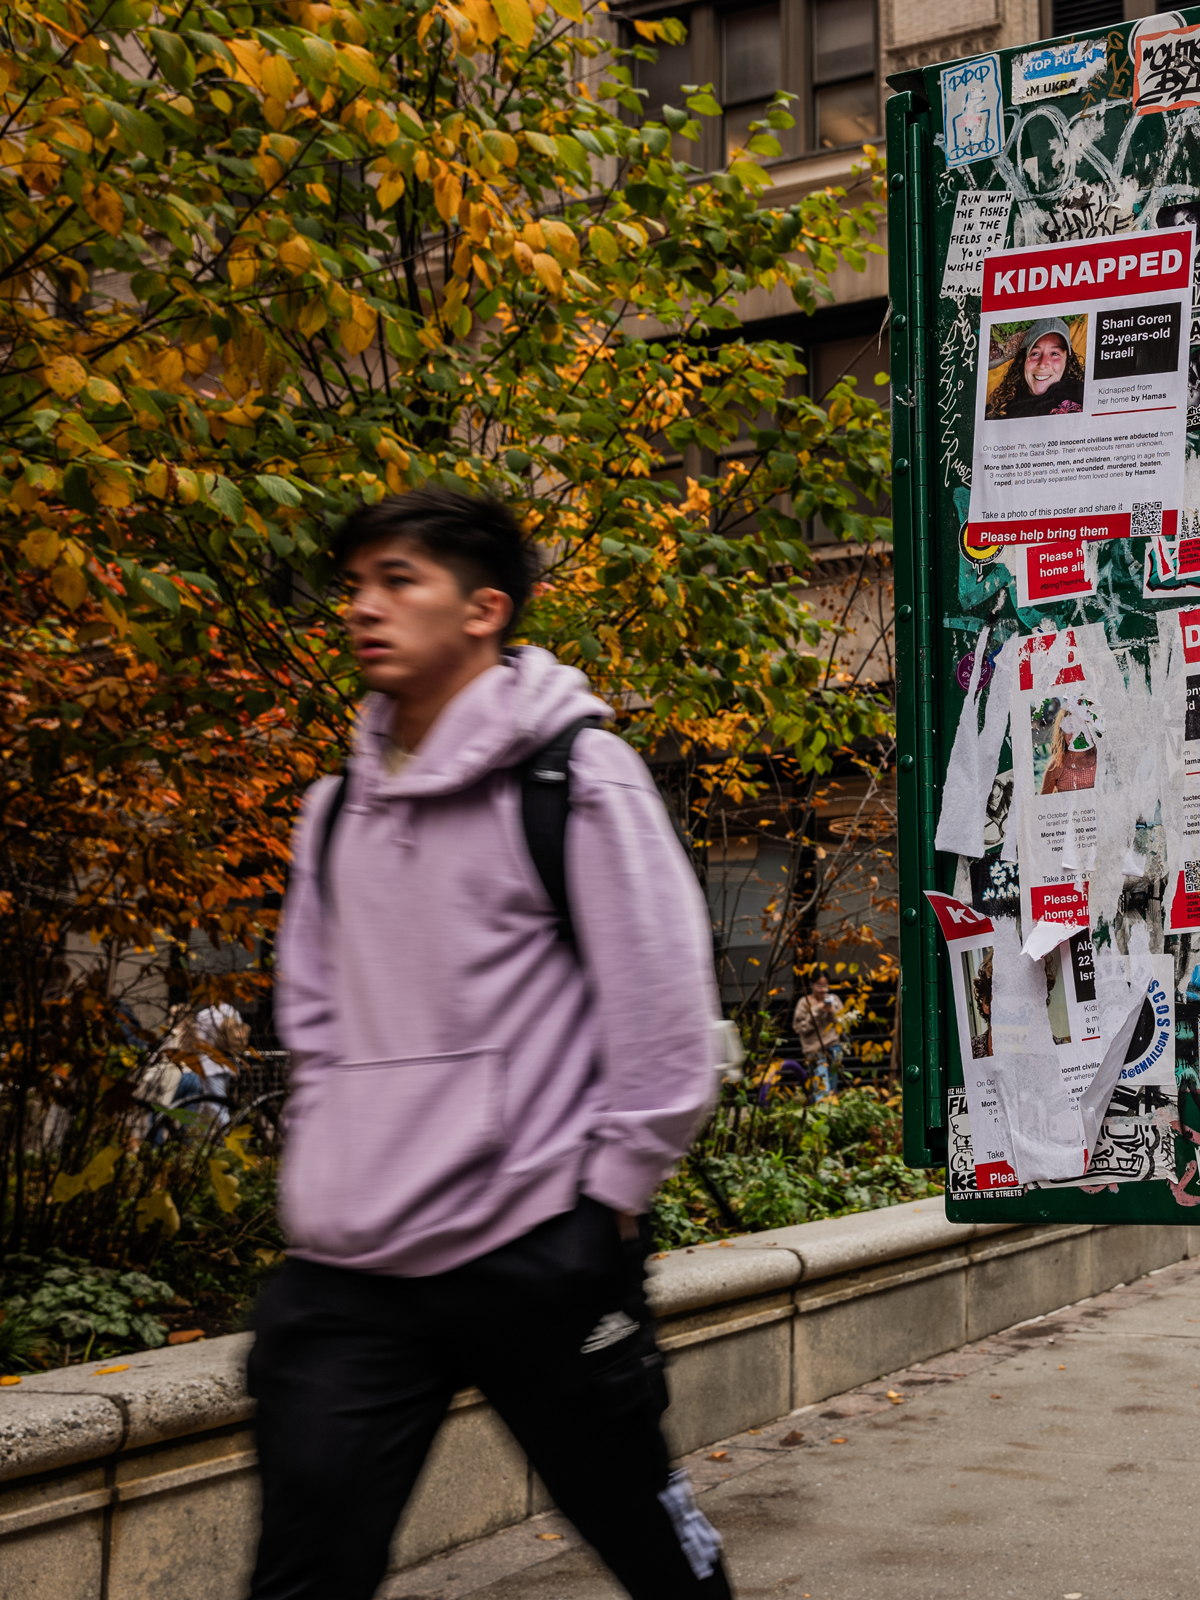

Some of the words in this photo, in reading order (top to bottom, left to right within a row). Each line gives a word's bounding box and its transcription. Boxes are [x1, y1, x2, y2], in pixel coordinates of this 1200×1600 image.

[961, 194, 981, 206] RUN
[988, 193, 1011, 203] WITH
[956, 209, 974, 218] THE
[980, 207, 1008, 217] FISHES
[964, 223, 974, 231] IN
[980, 220, 1000, 229] THE
[951, 234, 981, 244] FIELDS
[988, 233, 1002, 244] OF
[994, 249, 1183, 296] KIDNAPPED
[1103, 316, 1134, 330] Shani
[1137, 313, 1172, 326] Goren
[1101, 328, 1170, 345] 29-years-old
[1101, 347, 1134, 360] Israeli
[1099, 384, 1135, 395] Kidnapped
[1137, 383, 1152, 391] from
[1111, 396, 1129, 404] home
[1142, 392, 1166, 401] Hamas
[1060, 438, 1086, 446] innocent
[1087, 436, 1112, 444] civilians
[1130, 432, 1158, 440] abducted
[982, 511, 998, 520] Take
[1007, 509, 1028, 519] photo
[1030, 508, 1037, 516] of
[1039, 507, 1052, 516] this
[1054, 506, 1077, 517] poster
[1079, 505, 1093, 513] and
[1095, 504, 1114, 513] share
[1116, 503, 1123, 511] it
[980, 531, 1017, 543] Please
[1020, 529, 1044, 542] help
[1047, 528, 1077, 541] bring
[1080, 526, 1108, 537] them
[1040, 551, 1073, 563] Please
[1040, 566, 1068, 577] home
[1044, 894, 1078, 905] Please
[1045, 910, 1074, 919] home
[987, 1151, 1004, 1159] Take
[996, 1190, 1022, 1198] STREETS
